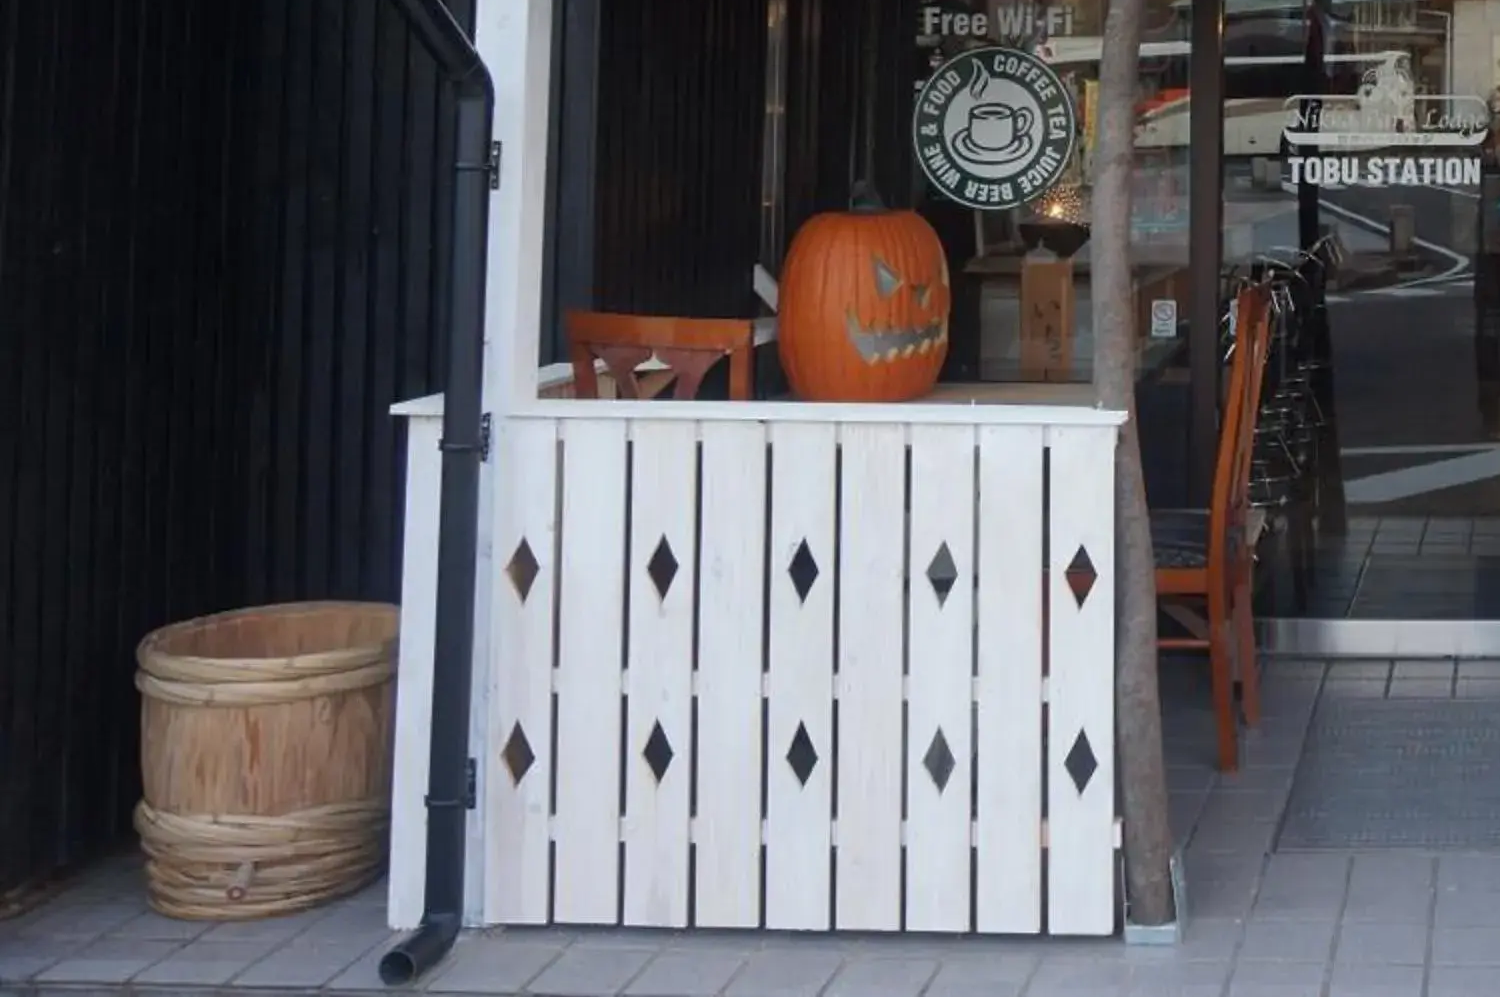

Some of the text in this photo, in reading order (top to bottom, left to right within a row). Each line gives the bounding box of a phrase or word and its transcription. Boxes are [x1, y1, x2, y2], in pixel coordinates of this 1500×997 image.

[923, 4, 1073, 36] Free Wi-Fi
[920, 54, 1067, 202] COFFEE TEA JUICE BEER WINE & FOOD
[1287, 156, 1481, 185] TOBU STATION
